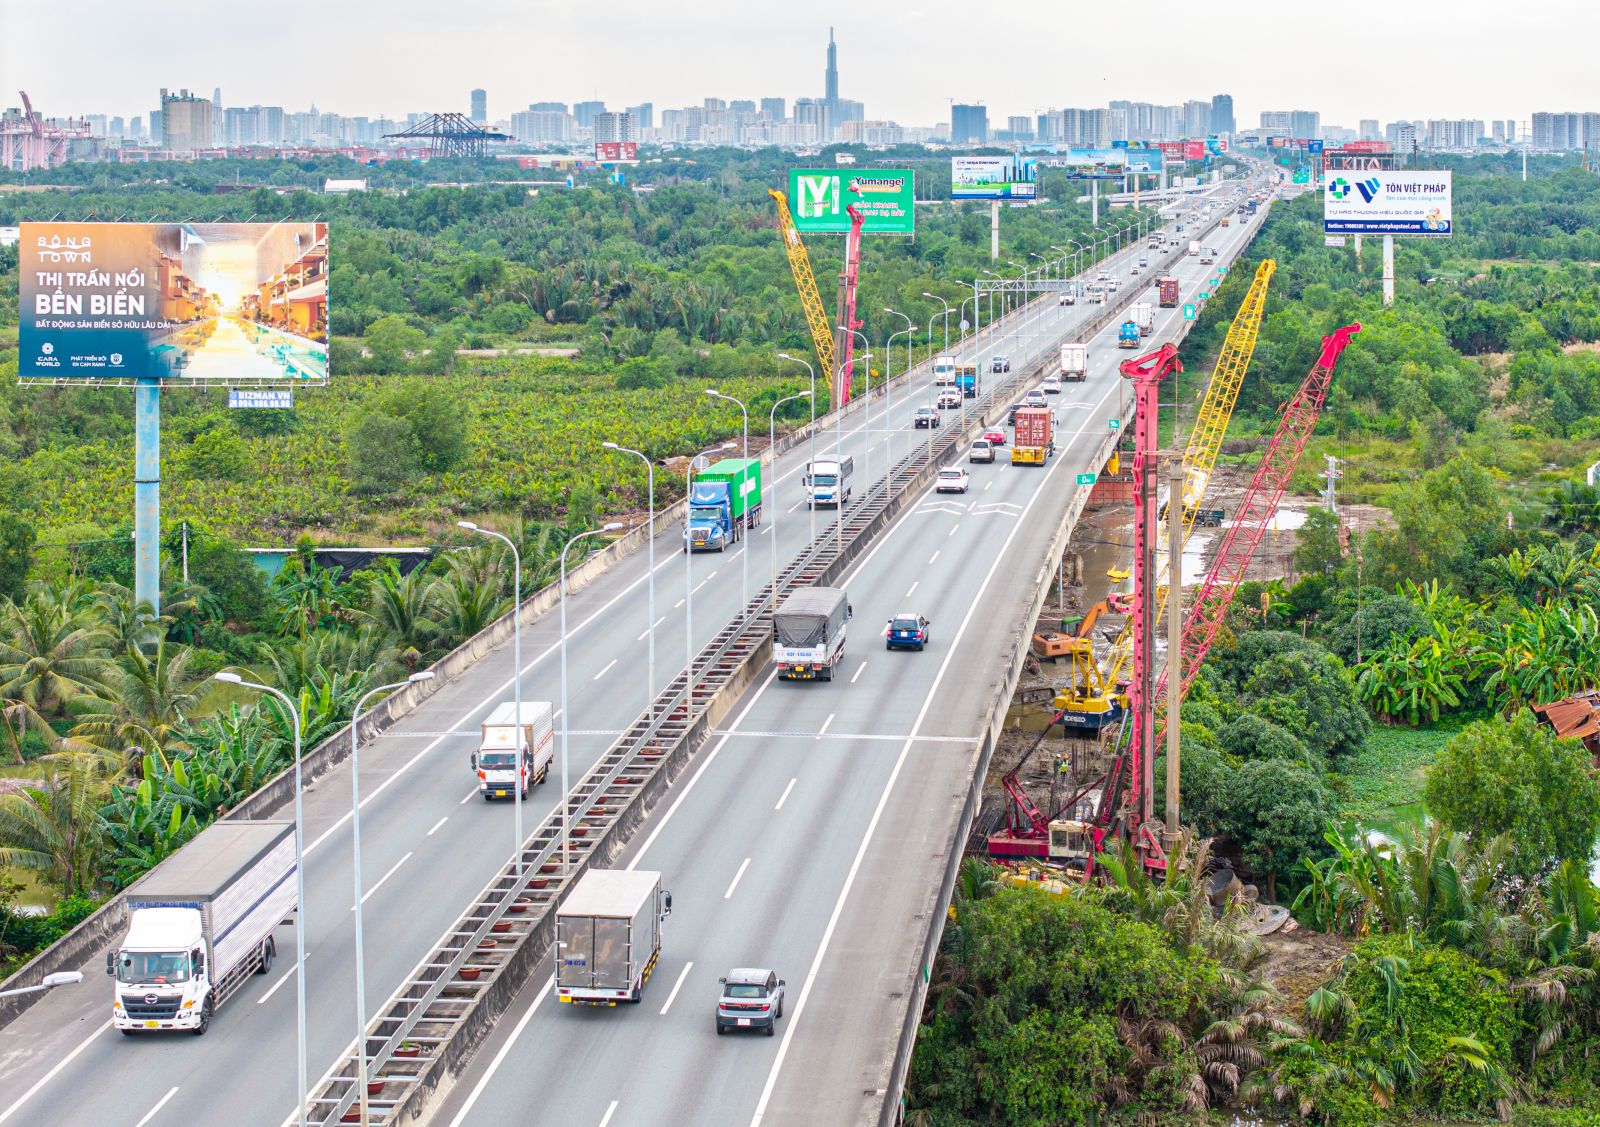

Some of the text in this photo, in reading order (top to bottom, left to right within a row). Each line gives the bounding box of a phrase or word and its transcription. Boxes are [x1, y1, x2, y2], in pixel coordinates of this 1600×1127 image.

[1342, 157, 1382, 170] KITA
[855, 176, 904, 187] Yumangel
[1385, 183, 1446, 195] TÔN VIỆT PHÁP
[37, 235, 91, 248] SÔNG
[38, 250, 91, 262] TOWN
[36, 267, 145, 289] THỊ TRẤN NỔI
[90, 288, 145, 315] BIỂN
[35, 319, 51, 328] BẤT
[52, 319, 75, 329] ĐỘNG
[141, 320, 156, 329] LÂU
[238, 391, 290, 400] BIZMAN.VN
